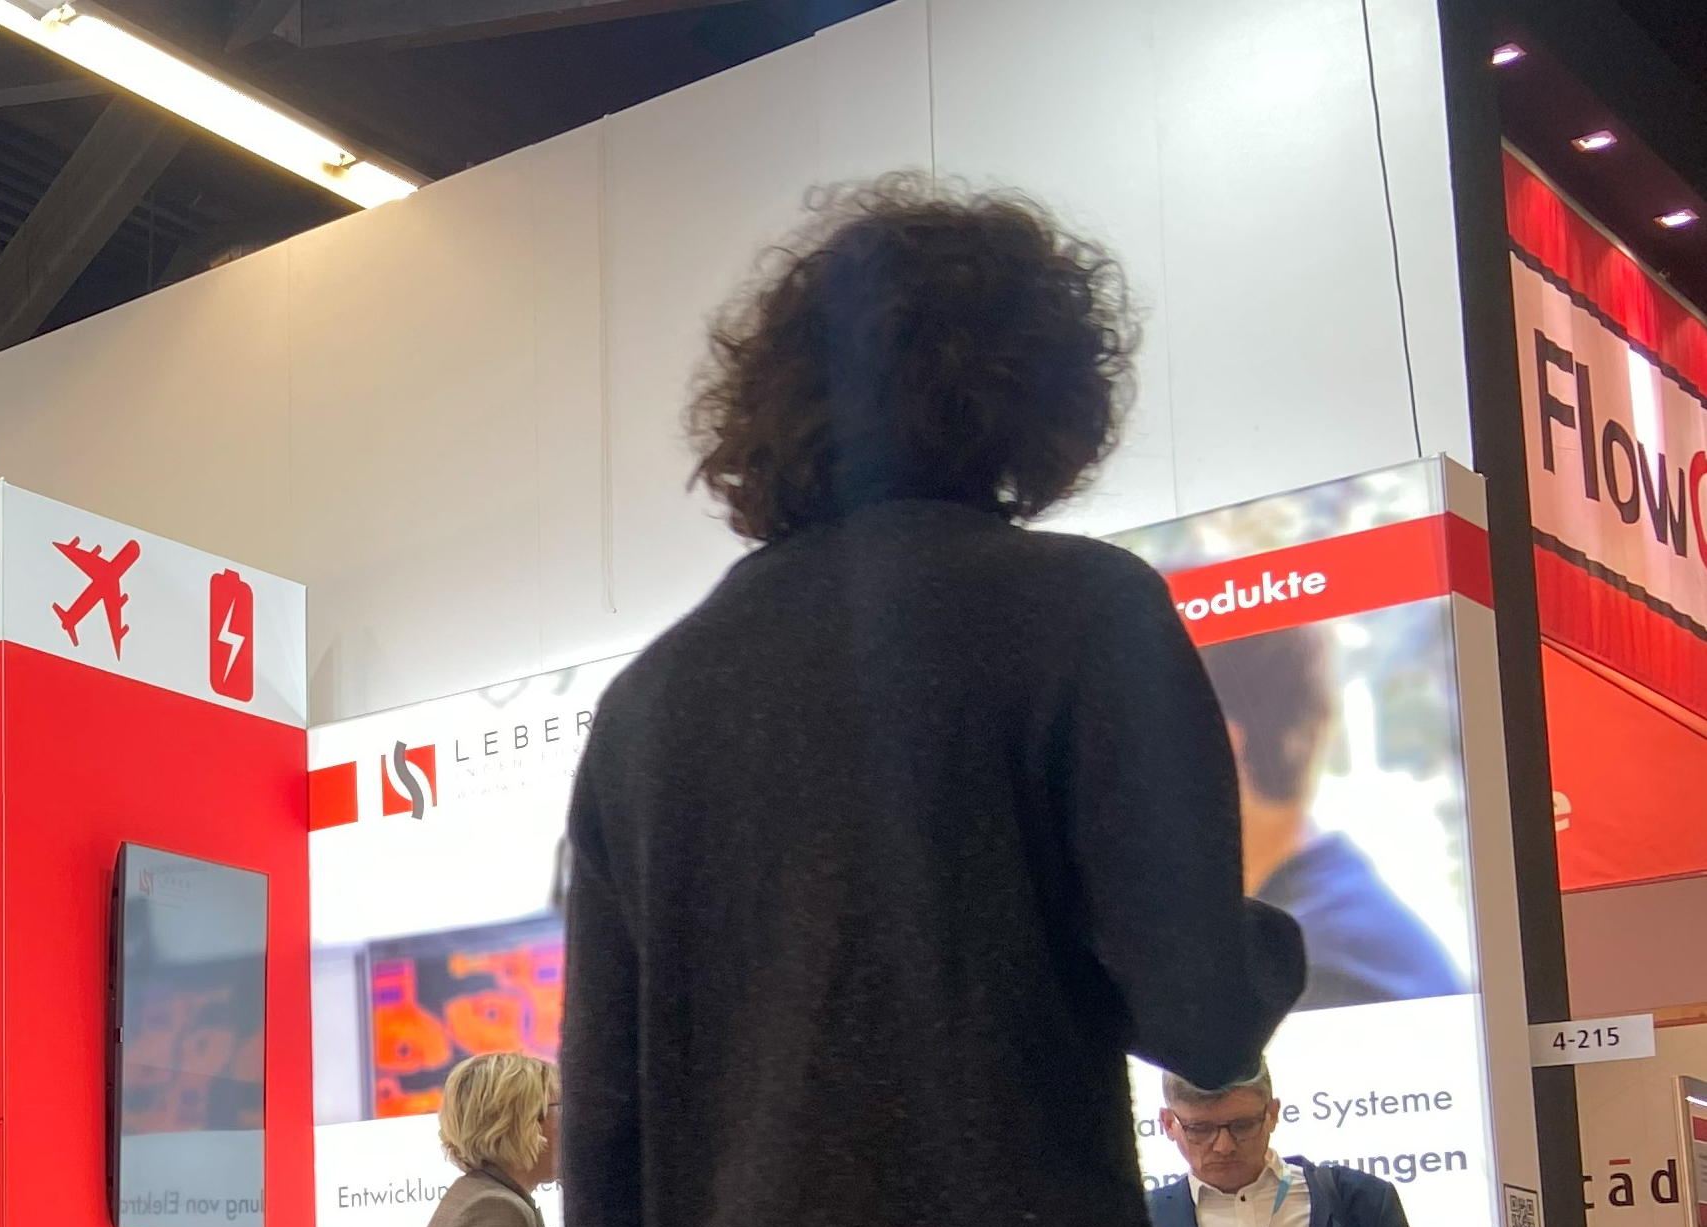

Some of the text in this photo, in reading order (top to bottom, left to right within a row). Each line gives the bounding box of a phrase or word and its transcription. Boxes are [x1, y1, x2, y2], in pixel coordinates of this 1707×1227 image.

[455, 710, 593, 762] LEBER
[1552, 1026, 1620, 1051] 4-215
[1312, 1090, 1453, 1128] Systeme
